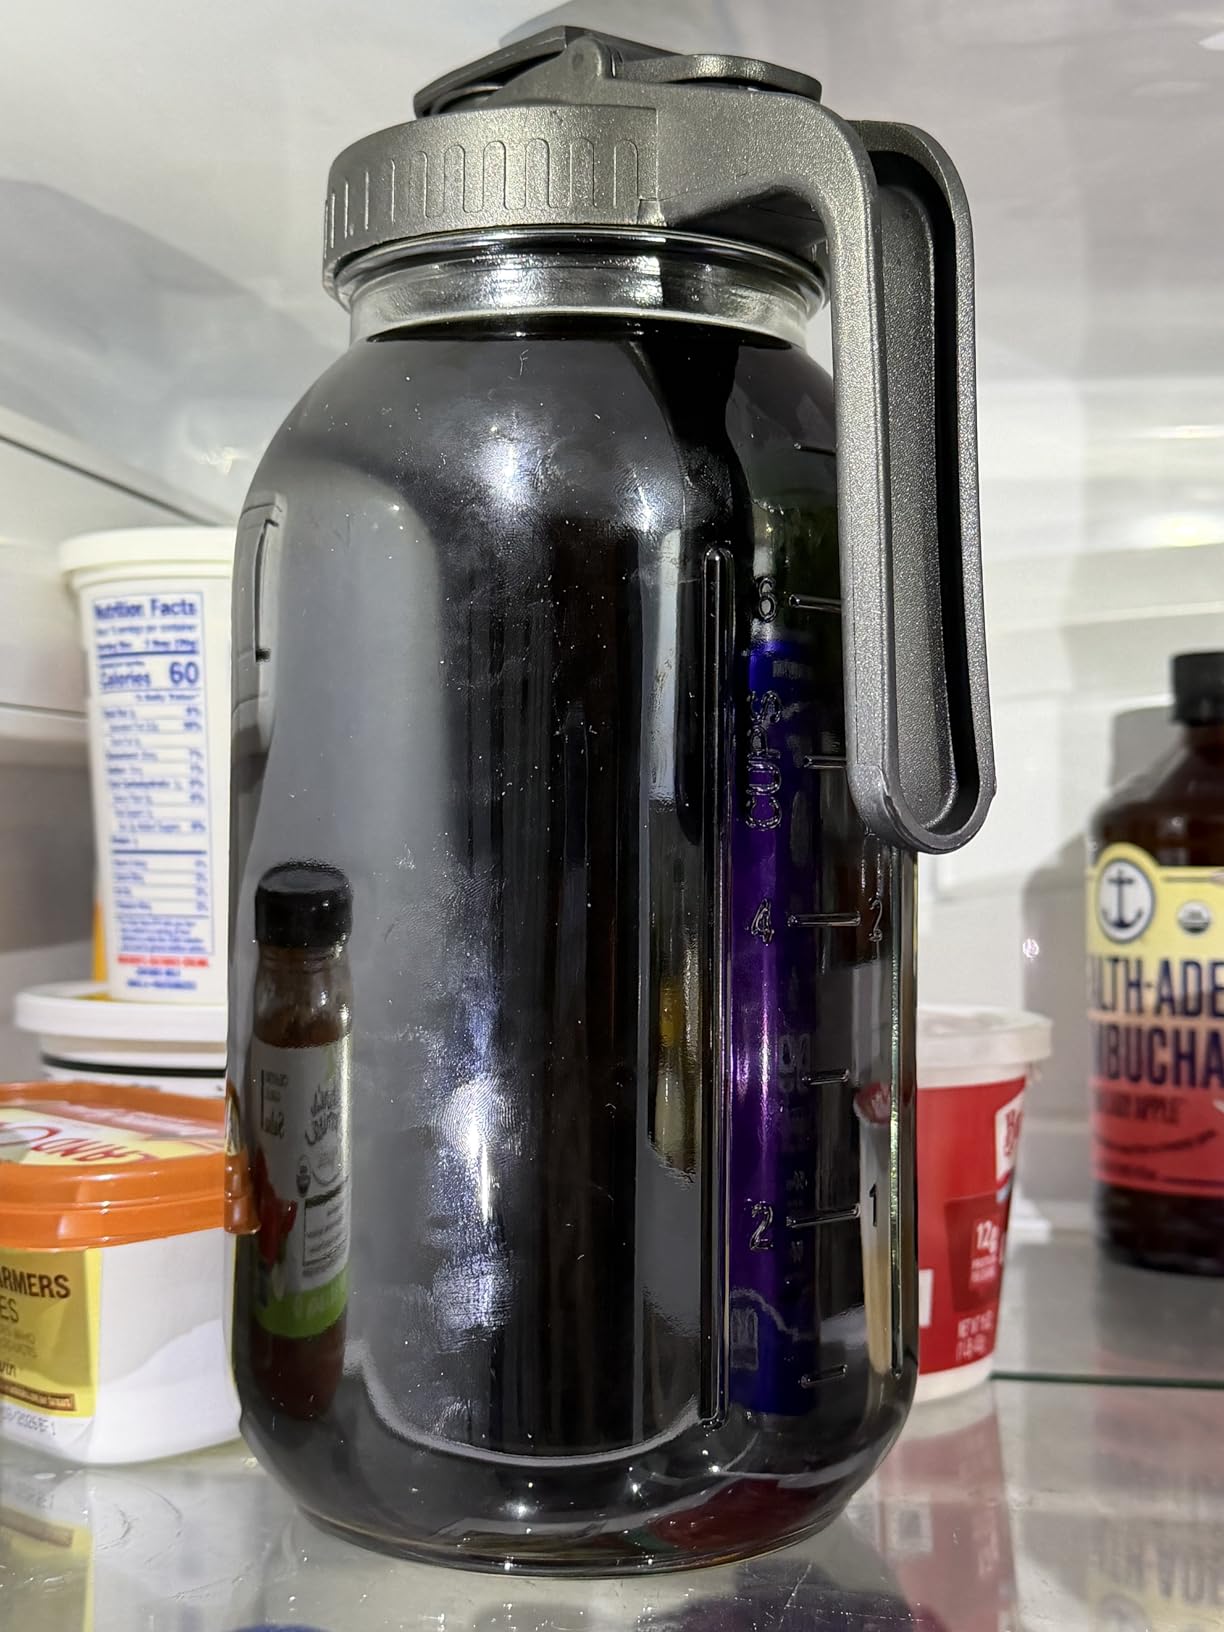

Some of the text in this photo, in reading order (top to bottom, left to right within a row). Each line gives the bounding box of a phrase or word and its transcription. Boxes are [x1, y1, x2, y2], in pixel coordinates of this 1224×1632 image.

[151, 598, 195, 616] Facts
[757, 577, 778, 622] 6
[169, 661, 199, 685] 60
[745, 691, 783, 831] CUPS
[750, 898, 775, 945] 4
[749, 1199, 775, 1251] 2
[868, 1184, 880, 1227] 1
